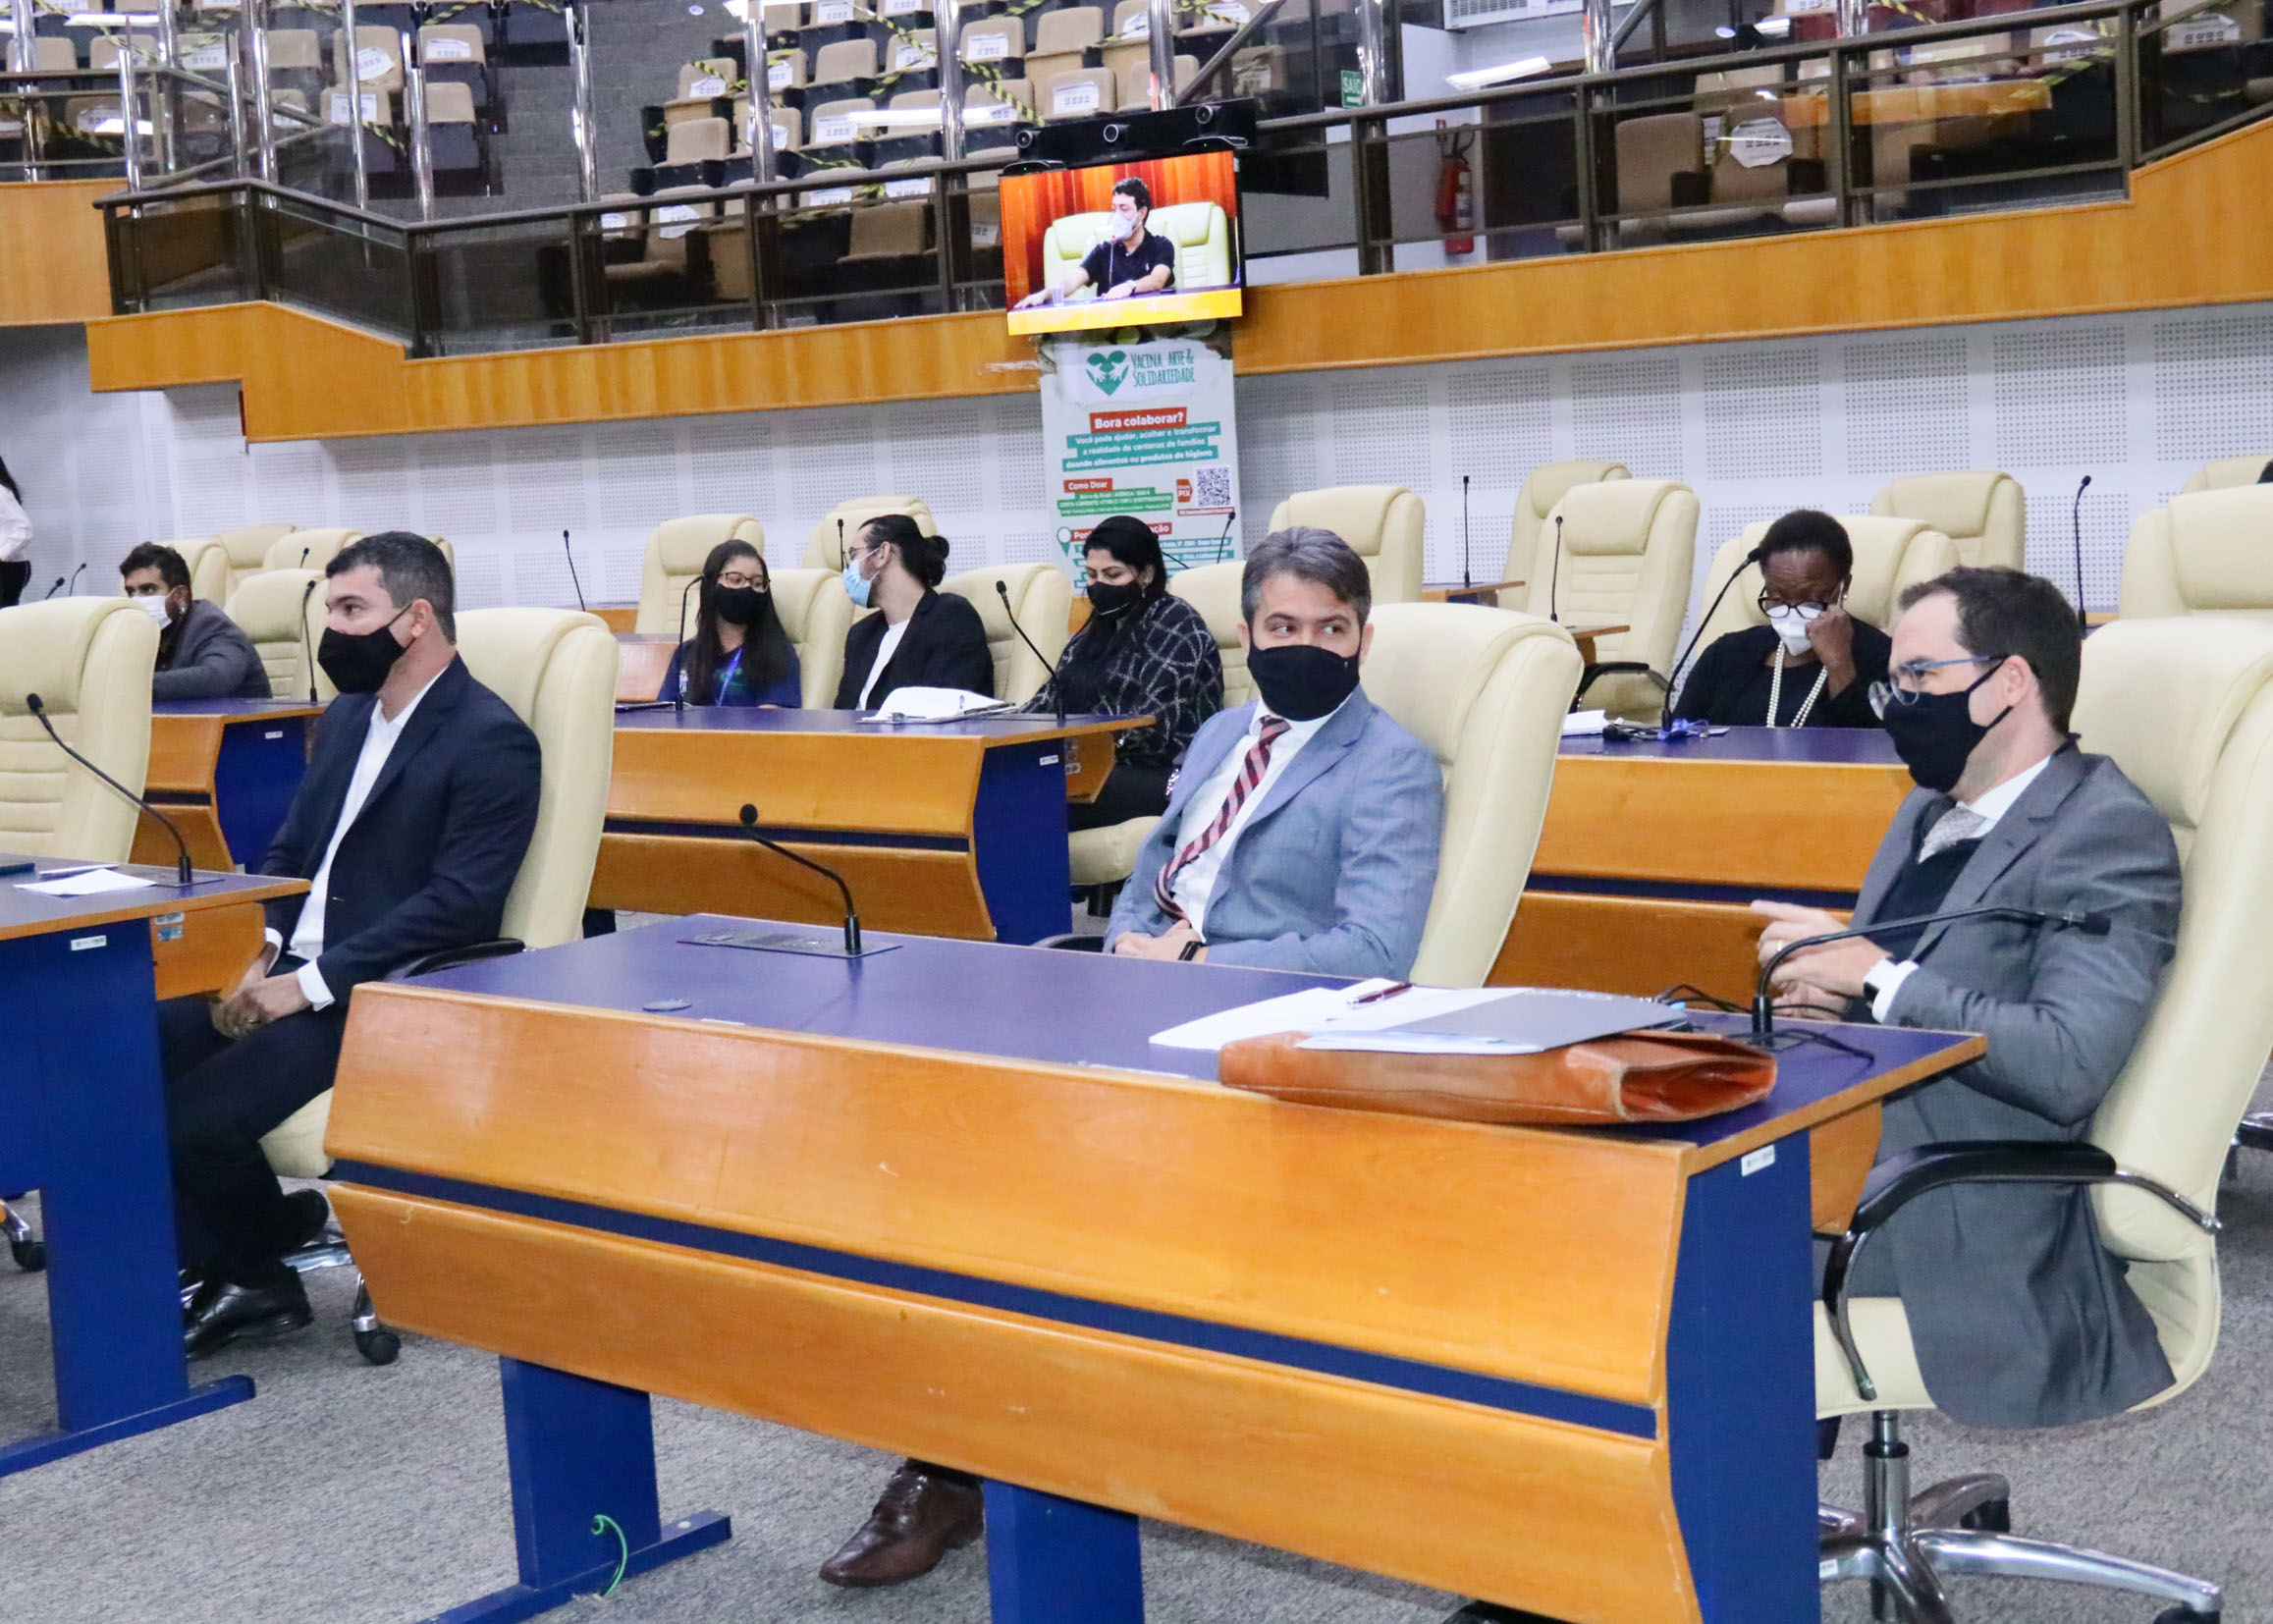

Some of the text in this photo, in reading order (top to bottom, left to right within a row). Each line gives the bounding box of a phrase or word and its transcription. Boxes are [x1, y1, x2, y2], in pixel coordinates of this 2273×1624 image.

[1132, 367, 1196, 387] SOLIDARIEDADE
[1095, 411, 1184, 429] Bora colaborar?
[1095, 435, 1112, 444] pode
[1140, 430, 1165, 439] acolher
[1173, 426, 1218, 435] transformar
[1089, 446, 1120, 455] realidade
[1133, 442, 1165, 451] centenas
[1095, 458, 1128, 466] alimentos
[1141, 453, 1173, 463] produtos
[1068, 480, 1108, 490] Como Doar
